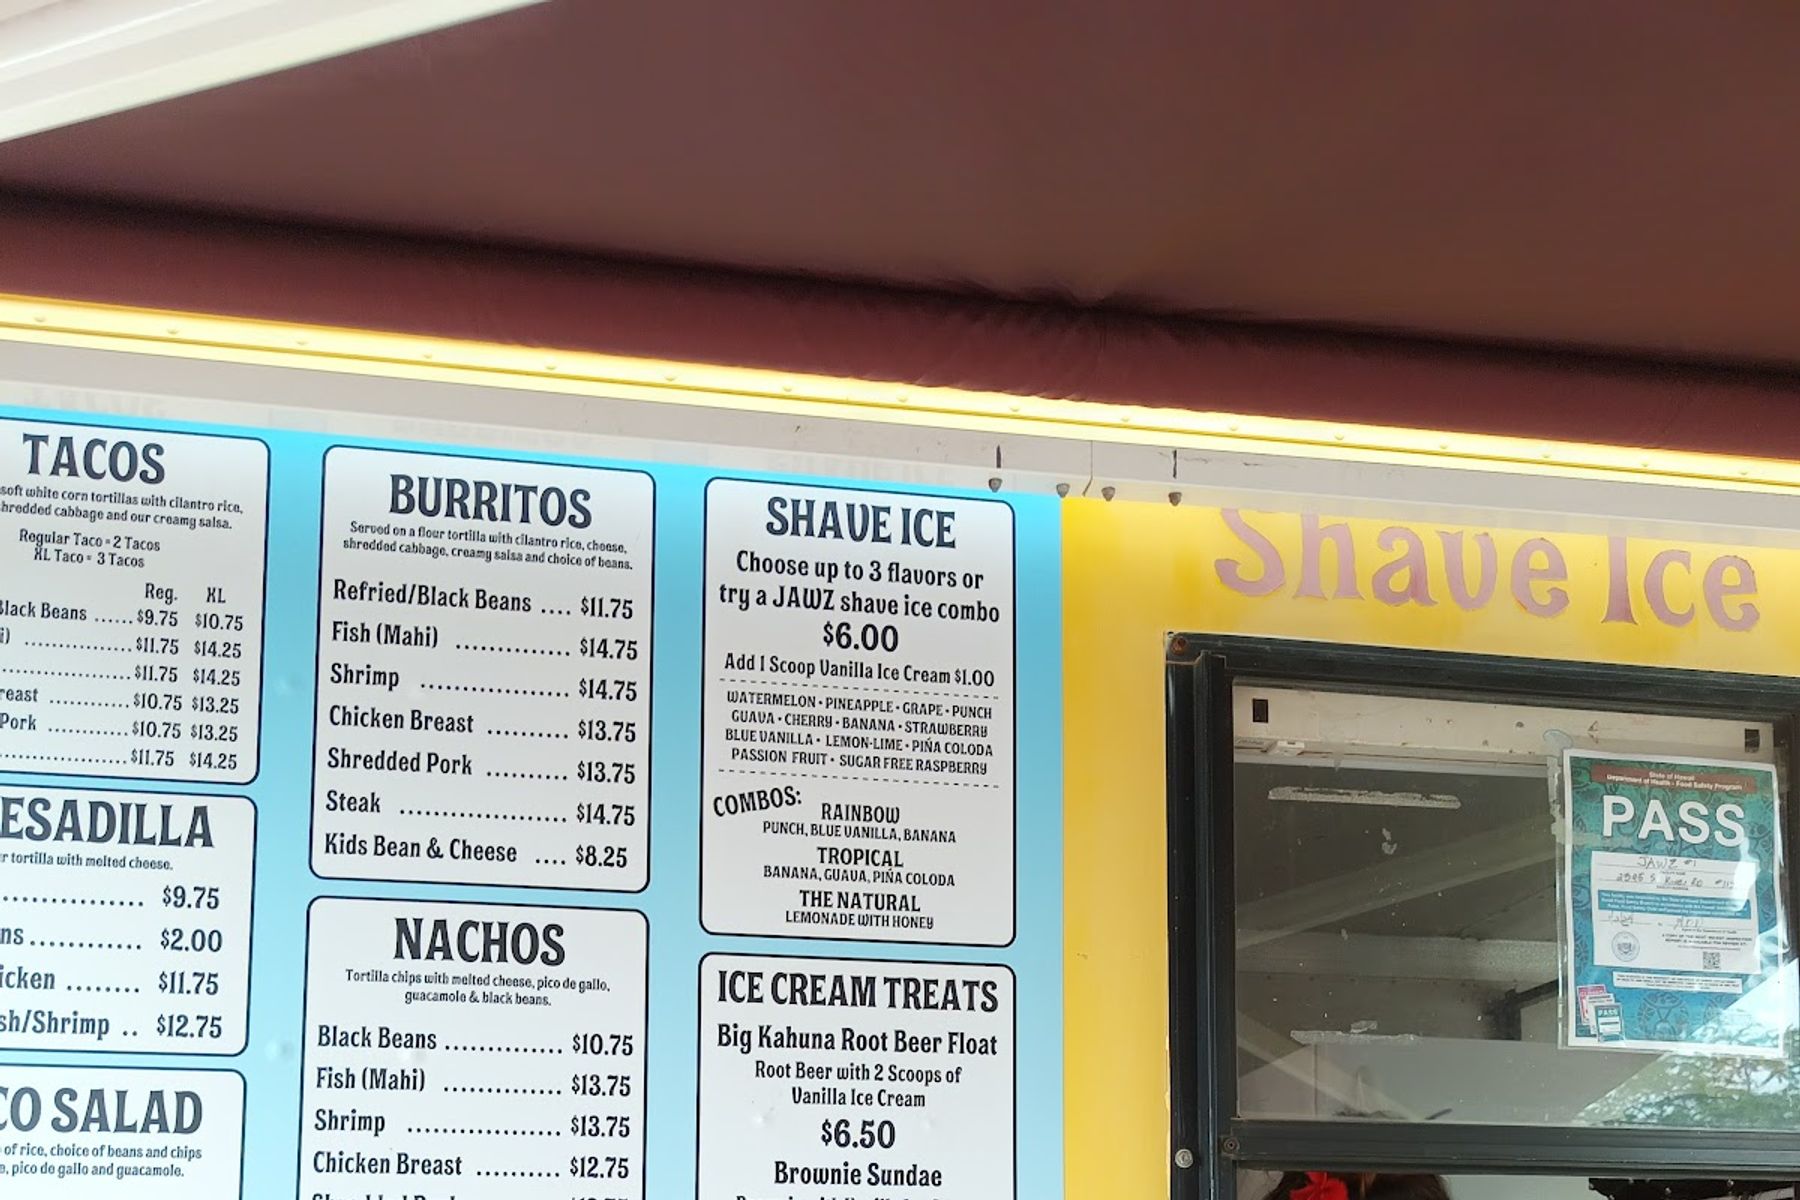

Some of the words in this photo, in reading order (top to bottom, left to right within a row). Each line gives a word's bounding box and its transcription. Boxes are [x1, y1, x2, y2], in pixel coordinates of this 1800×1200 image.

[23, 433, 165, 485] TACOS
[25, 486, 59, 499] white
[61, 490, 88, 501] corn
[91, 491, 139, 505] tortillas
[141, 494, 167, 507] with
[169, 496, 215, 511] cilantro
[217, 499, 243, 514] rice,
[389, 474, 592, 529] BURRITOS
[350, 520, 390, 535] Served
[393, 526, 407, 536] on
[408, 528, 415, 537] a
[418, 526, 445, 539] flour
[447, 529, 486, 543] tortilla
[489, 531, 513, 544] with
[515, 533, 558, 548] cilantro
[560, 537, 585, 551] rice,
[586, 539, 627, 554] cheese,
[766, 496, 892, 544] SHAVE
[901, 507, 956, 549] ICE
[736, 550, 809, 576] Choose
[815, 562, 838, 583] up
[844, 561, 864, 580] to
[869, 560, 882, 582] 3
[887, 562, 957, 588] flavors
[962, 573, 984, 589] or
[1214, 507, 1571, 619] Shave
[1600, 534, 1761, 632] Ice
[145, 582, 178, 604] Reg.
[206, 587, 226, 604] XL
[333, 578, 469, 608] Refried/Black
[475, 589, 531, 612] Beans
[581, 596, 633, 620] $11.75
[40, 602, 87, 621] Beans
[137, 609, 178, 627] $9.75
[195, 613, 243, 631] $10.75
[332, 621, 370, 643] Fish
[376, 622, 438, 648] (Mahi)
[580, 637, 638, 661] $14.75
[823, 621, 898, 652] $6.00
[133, 693, 182, 711] $10.75
[192, 696, 239, 714] $13.25
[727, 690, 816, 708] WATERMELON
[825, 697, 894, 713] PINEAPPLE
[902, 702, 943, 716] GRAPE
[952, 705, 992, 719] PUNCH
[713, 785, 802, 817] COMBOS:
[821, 802, 900, 824] RAINBOW
[1602, 794, 1745, 847] PASS
[11, 851, 54, 865] tortilla
[56, 853, 83, 866] with
[85, 855, 127, 868] melted
[129, 856, 173, 870] cheese.
[325, 832, 368, 855] Kids
[373, 835, 420, 857] Bean
[426, 837, 444, 859] &
[449, 838, 517, 862] Cheese
[576, 844, 627, 868] $8.25
[817, 846, 904, 868] TROPICAL
[162, 885, 219, 910] $9.75
[799, 889, 833, 908] THE
[837, 891, 921, 912] NATURAL
[786, 910, 855, 926] LEMONADE
[857, 913, 890, 927] WITH
[892, 915, 934, 930] HONEY
[160, 928, 222, 953] $2.00
[393, 917, 565, 967] NACHOS
[405, 990, 466, 1005] guacamole
[469, 990, 480, 1003] &
[482, 991, 513, 1005] black
[515, 992, 551, 1006] beans.
[718, 970, 764, 1003] ICE
[771, 972, 876, 1007] CREAM
[883, 976, 998, 1013] TREATS
[717, 1023, 752, 1055] Big
[758, 1025, 835, 1050] Kahuna
[841, 1027, 888, 1052] Root
[894, 1029, 942, 1053] Beer
[948, 1032, 997, 1056] Float
[51, 1087, 203, 1135] SALAD
[821, 1118, 895, 1149] $6.50
[4, 1143, 18, 1156] of
[19, 1142, 48, 1157] rice,
[50, 1143, 90, 1157] choice
[91, 1144, 106, 1157] of
[107, 1144, 144, 1158] beans
[145, 1145, 168, 1158] and
[170, 1145, 202, 1162] chips
[774, 1161, 861, 1185] Brownie
[867, 1162, 942, 1187] Sundae
